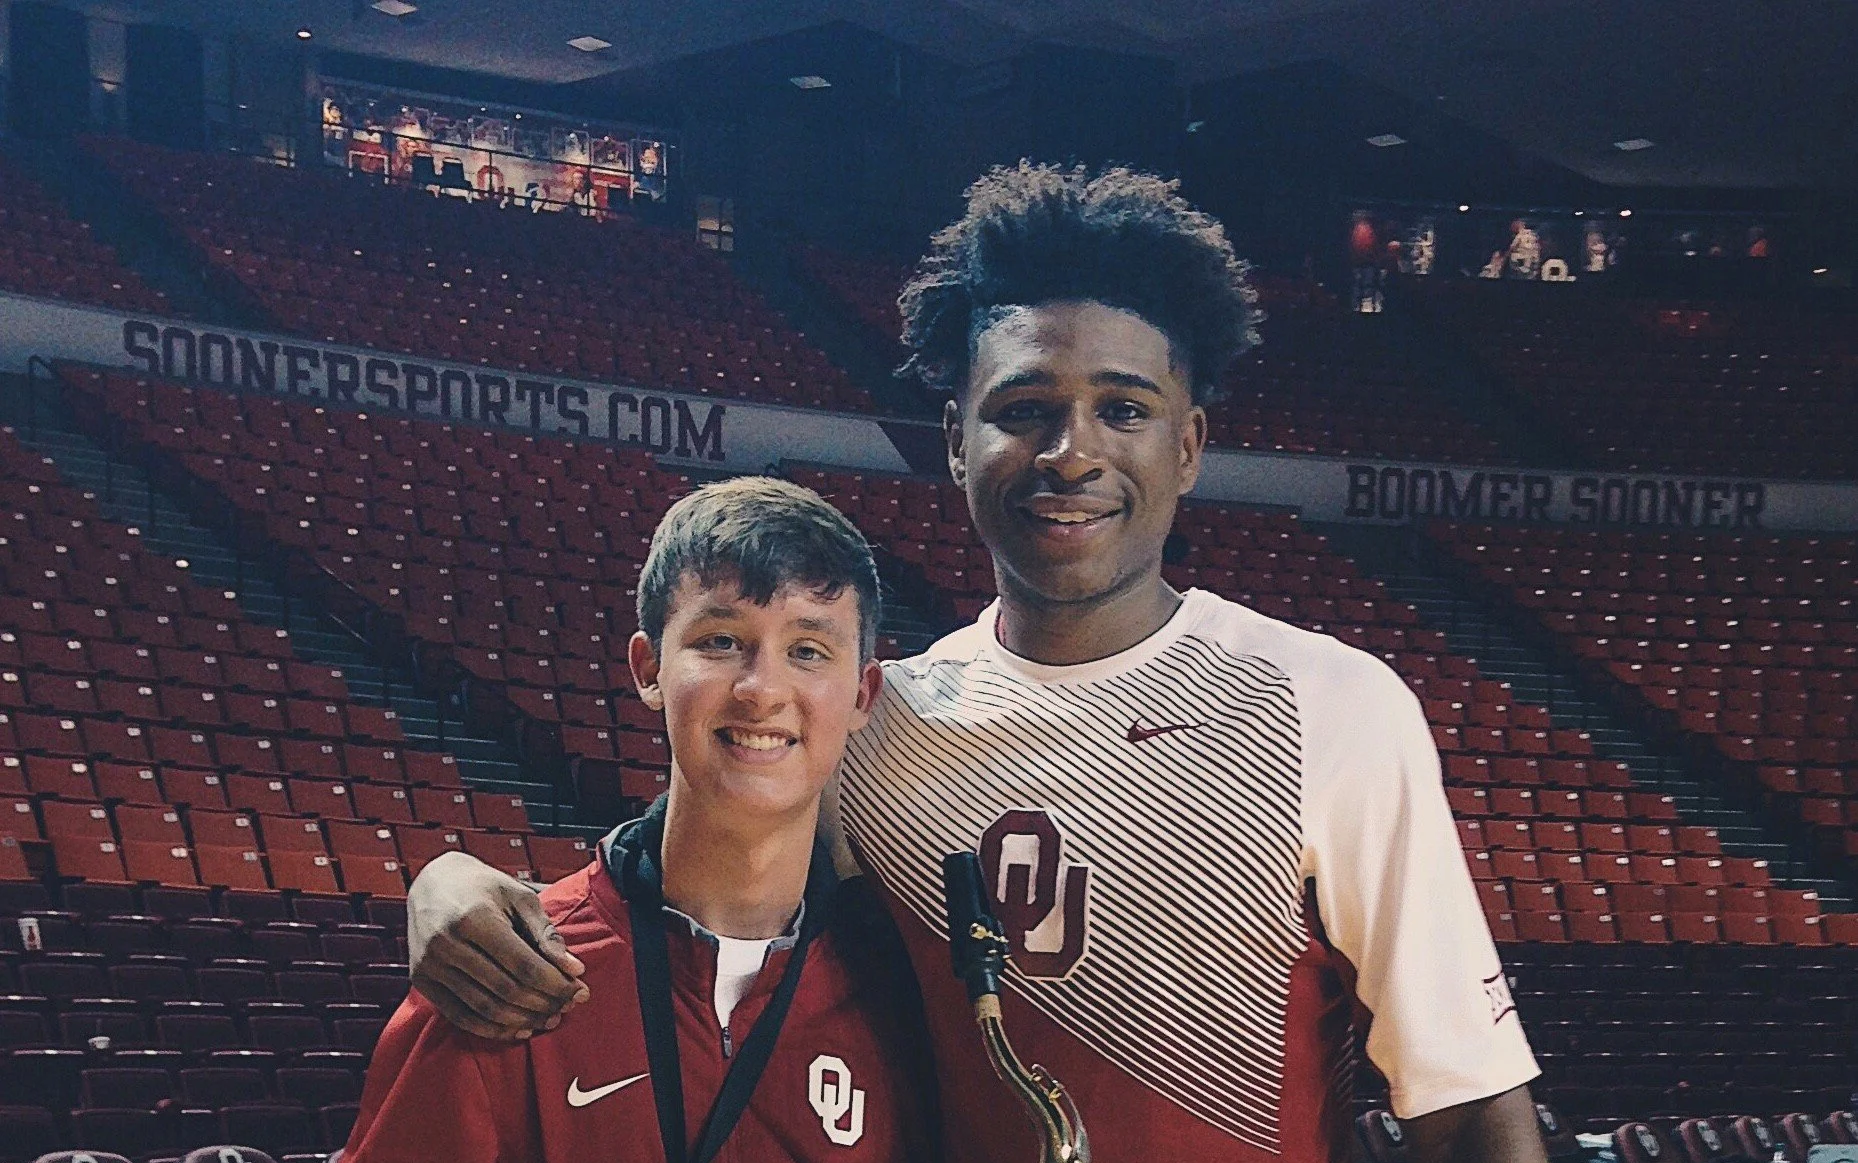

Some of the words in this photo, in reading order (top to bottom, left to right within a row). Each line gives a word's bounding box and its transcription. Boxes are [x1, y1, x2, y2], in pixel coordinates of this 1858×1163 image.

[123, 320, 727, 462] SOONERSPORTSCOM
[1345, 464, 1551, 521] BOOMER
[1570, 477, 1766, 526] SOONER
[978, 809, 1092, 980] OU
[808, 1054, 865, 1146] OU
